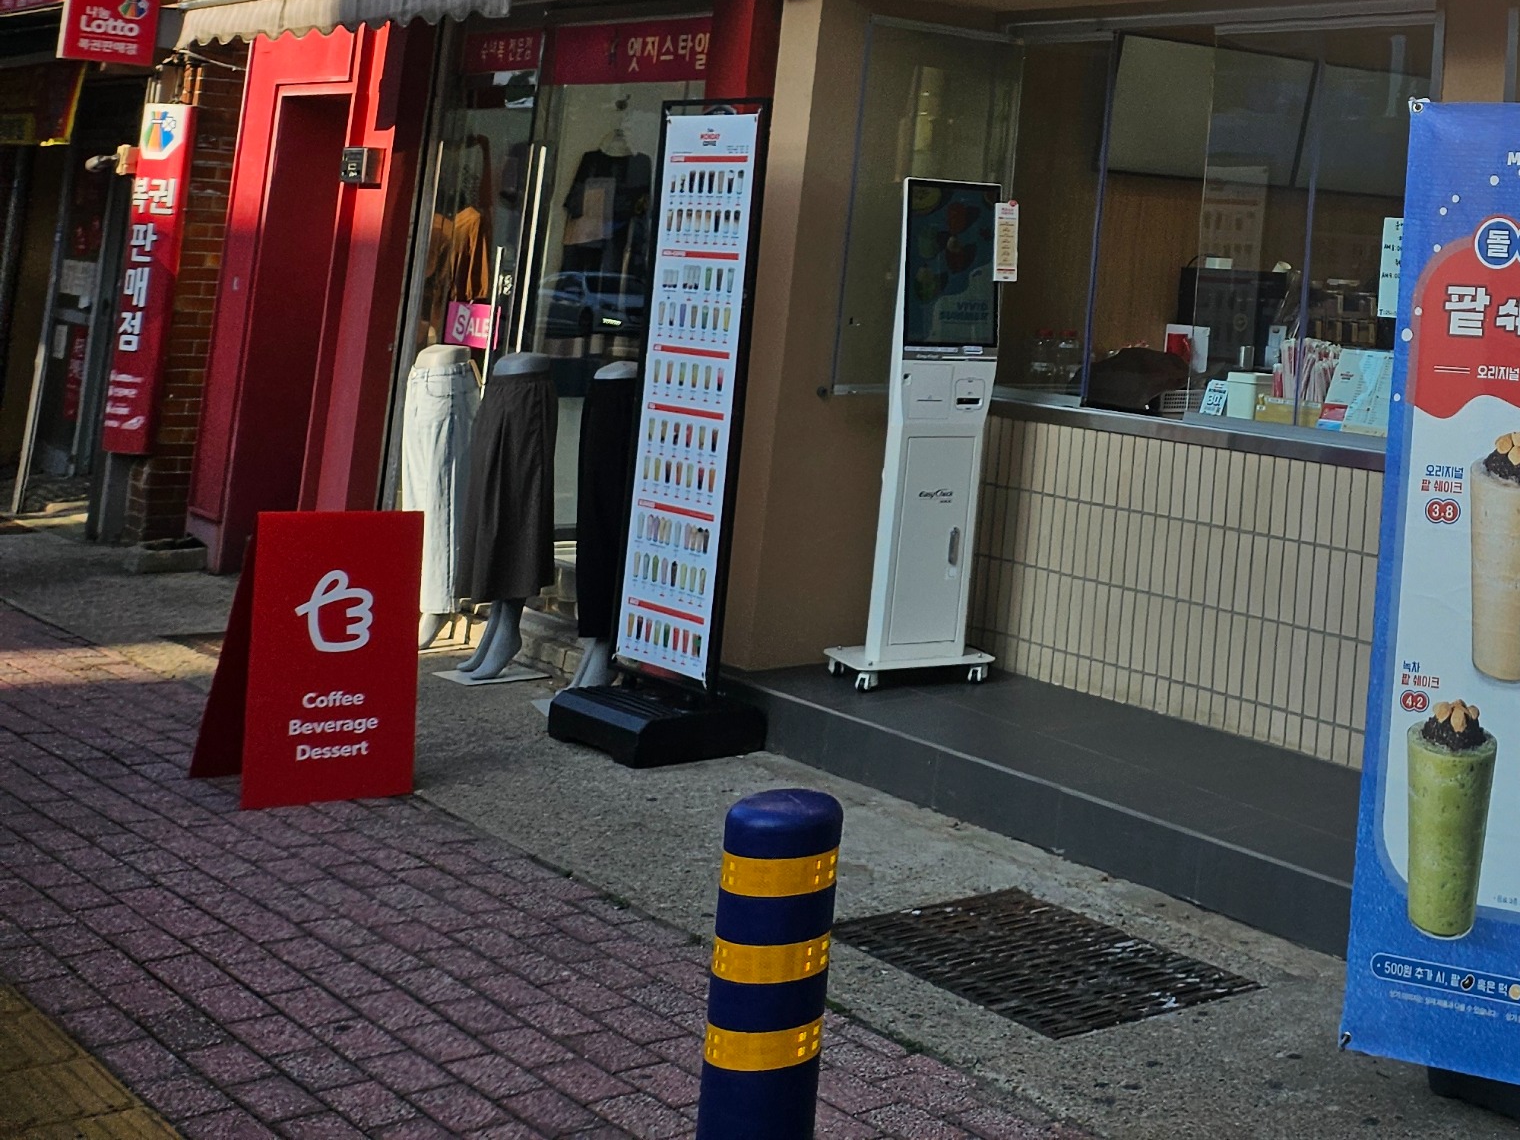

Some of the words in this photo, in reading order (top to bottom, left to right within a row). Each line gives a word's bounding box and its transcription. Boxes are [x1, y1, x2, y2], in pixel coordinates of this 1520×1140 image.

[80, 14, 140, 37] Lotto
[627, 32, 710, 73] 엣지스타일
[1444, 286, 1491, 338] 팥
[456, 314, 490, 338] SALE
[1477, 365, 1520, 382] 오리지널
[1425, 464, 1464, 479] 오리지널
[1421, 479, 1431, 492] 팥
[1433, 480, 1463, 494] 쉐이크
[1432, 504, 1454, 519] 3.8
[1402, 660, 1420, 673] 녹차
[1413, 675, 1440, 689] 쉐이크
[302, 691, 365, 709] Coffee
[1405, 694, 1424, 708] 4.2
[288, 715, 379, 737] Beverage
[296, 740, 369, 761] Dessert
[1384, 961, 1412, 978] 500원
[1414, 967, 1433, 981] 추가
[1477, 979, 1496, 994] 혹은
